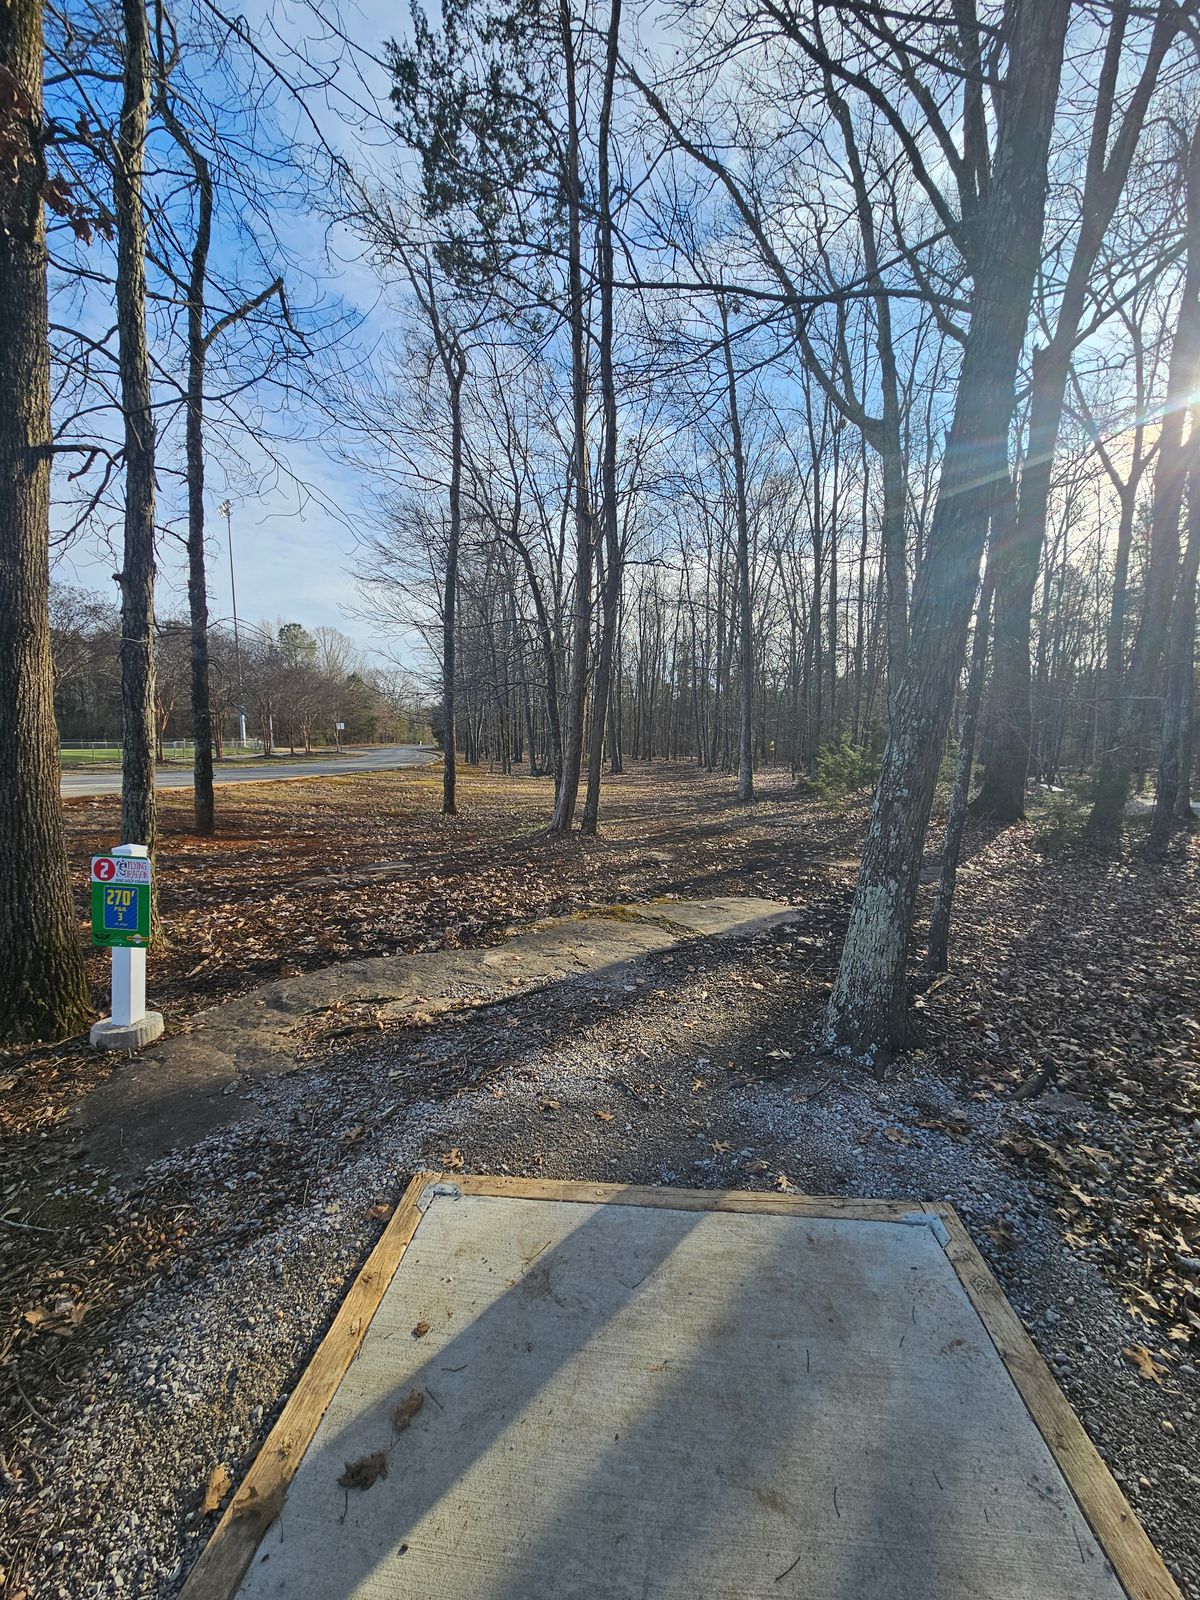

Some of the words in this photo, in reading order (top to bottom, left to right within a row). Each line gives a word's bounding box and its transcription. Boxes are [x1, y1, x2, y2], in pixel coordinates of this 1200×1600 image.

[100, 862, 109, 878] 2
[127, 861, 147, 870] FLYING
[125, 870, 148, 879] DRAGON
[117, 913, 123, 921] 3
